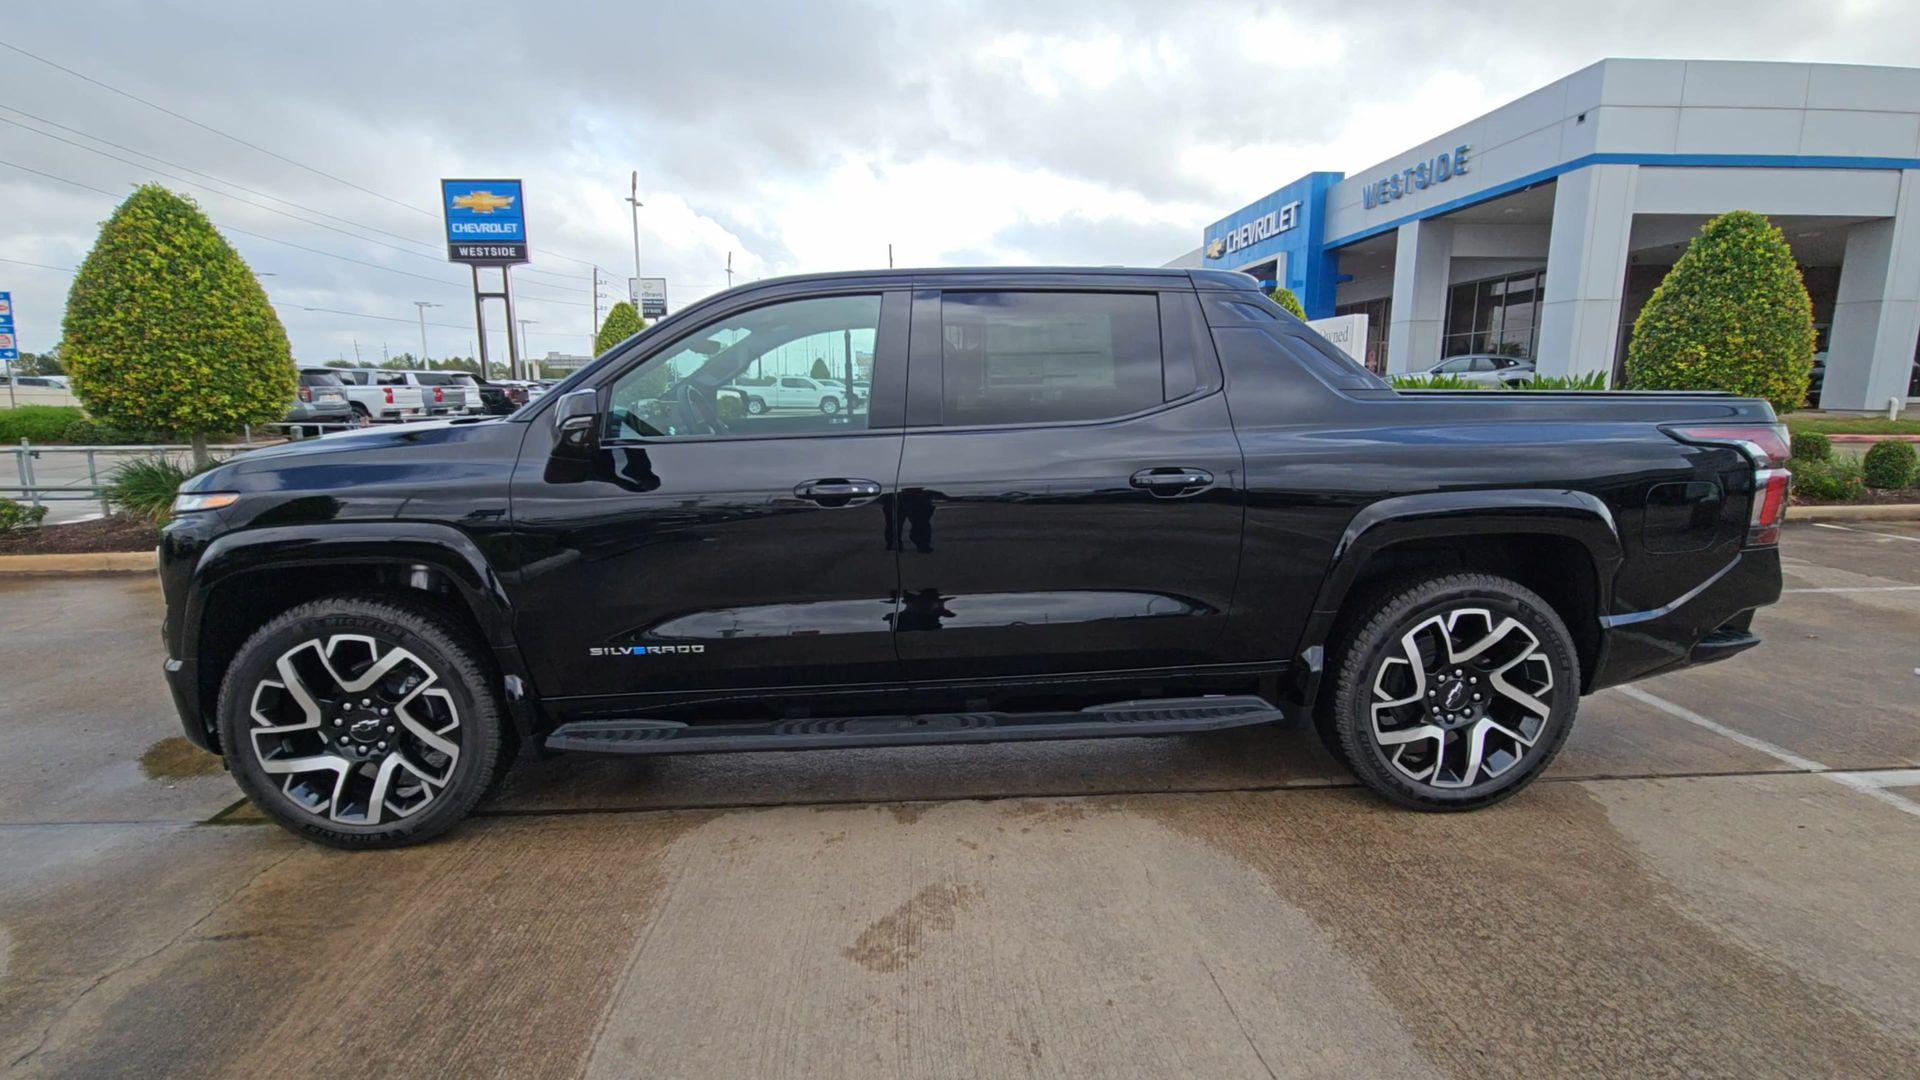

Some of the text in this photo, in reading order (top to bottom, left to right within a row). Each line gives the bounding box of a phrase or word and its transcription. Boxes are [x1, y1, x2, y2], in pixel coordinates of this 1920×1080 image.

[1363, 144, 1470, 209] WESTSIDE
[451, 223, 518, 233] CHEVROLET
[1225, 200, 1301, 253] CHEVROLET
[458, 246, 517, 257] WESTSIDE
[589, 645, 704, 655] SILVERADO
